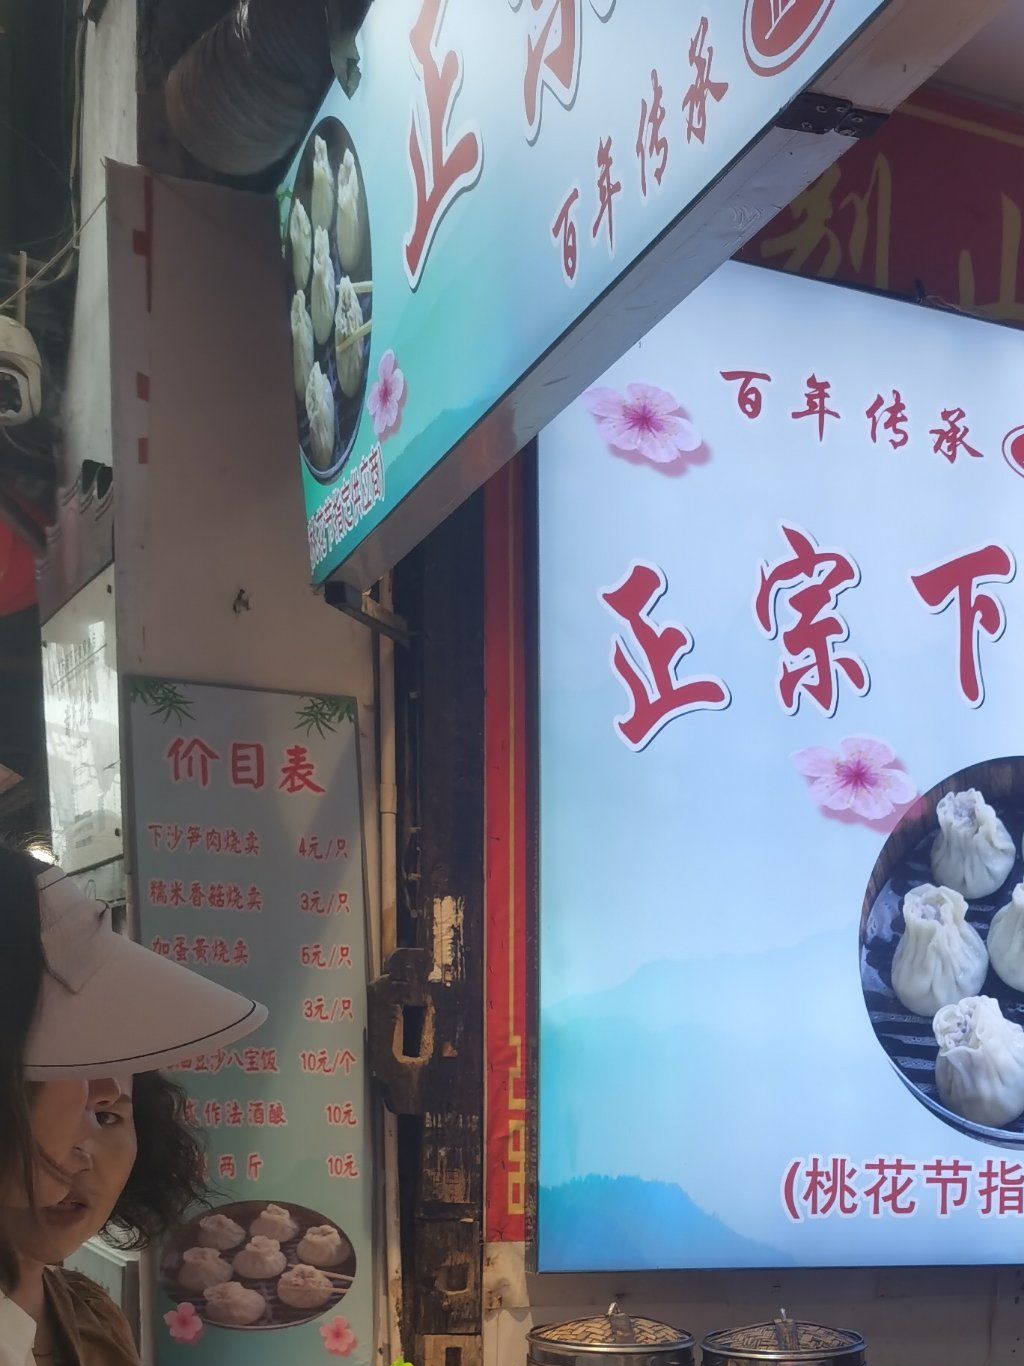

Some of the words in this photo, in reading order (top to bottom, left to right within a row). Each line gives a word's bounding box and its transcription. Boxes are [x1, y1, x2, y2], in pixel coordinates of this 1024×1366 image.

[552, 16, 729, 281] 百年传承
[720, 370, 983, 464] 百年传承
[165, 736, 327, 794] 价目表
[147, 823, 261, 857] 下沙笋肉烧卖
[299, 835, 349, 861] 4元/只
[300, 889, 351, 915] 3元/只
[152, 935, 250, 966] 加蛋黄烧卖
[303, 998, 354, 1022] 3元/只
[168, 1049, 278, 1075] 豆沙八宝饭
[300, 1050, 357, 1074] 10元/个
[325, 1104, 358, 1127] 10元
[328, 1155, 359, 1178] 10元
